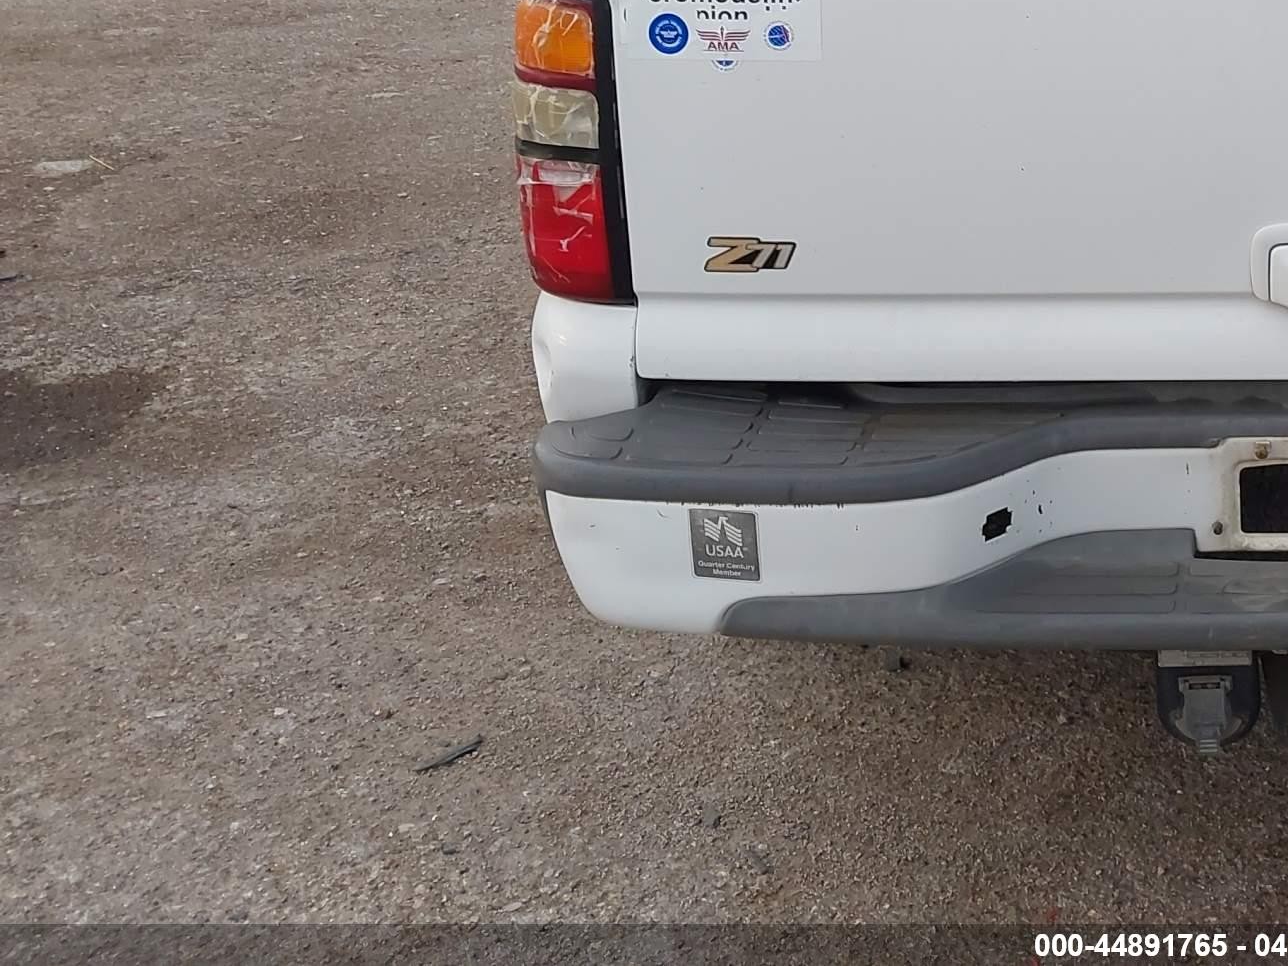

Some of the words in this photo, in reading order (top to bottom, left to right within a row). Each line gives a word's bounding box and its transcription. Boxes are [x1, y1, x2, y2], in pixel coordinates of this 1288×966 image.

[707, 42, 740, 51] AMA
[704, 237, 796, 273] Z71
[705, 544, 744, 559] USAA
[698, 560, 725, 569] Quarter
[726, 562, 755, 572] Century
[712, 568, 741, 577] Member
